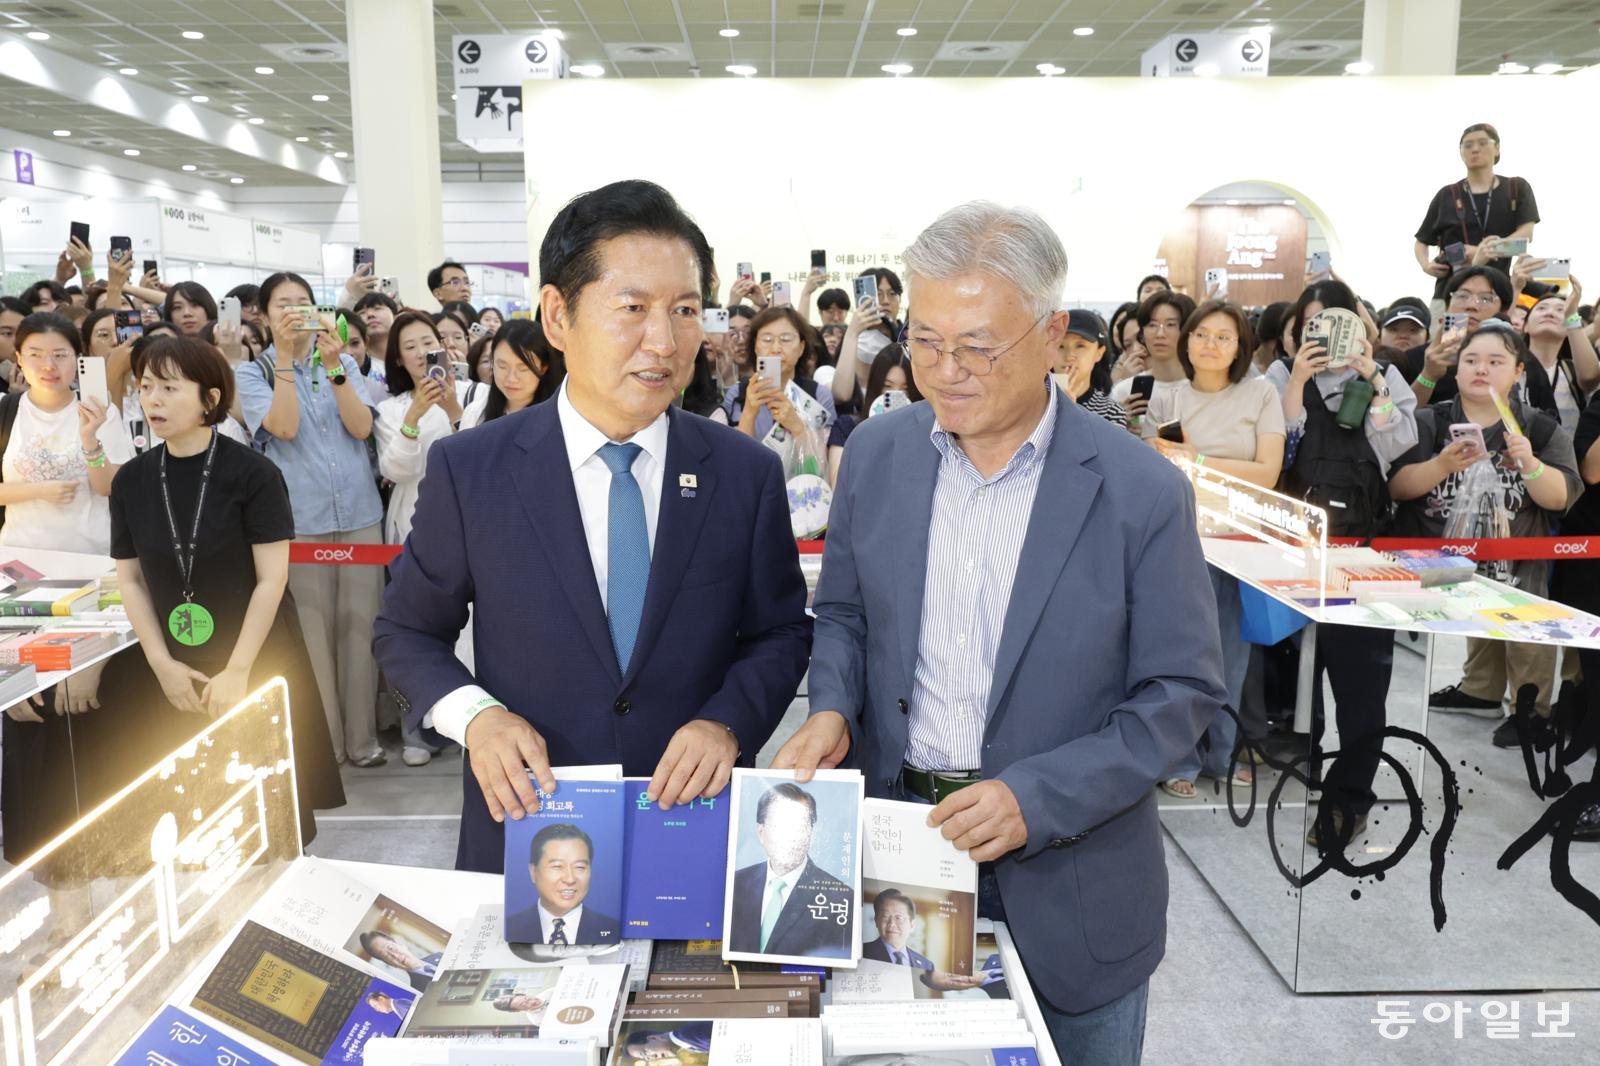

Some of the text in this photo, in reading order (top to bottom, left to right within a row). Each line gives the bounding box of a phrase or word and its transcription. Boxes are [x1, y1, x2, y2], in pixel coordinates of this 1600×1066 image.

[314, 547, 353, 561] coex
[1554, 540, 1589, 554] coex
[546, 801, 574, 812] 회고록
[872, 814, 893, 826] 결국
[871, 826, 902, 842] 국민이
[872, 840, 904, 856] 합니다
[807, 893, 849, 925] 운명
